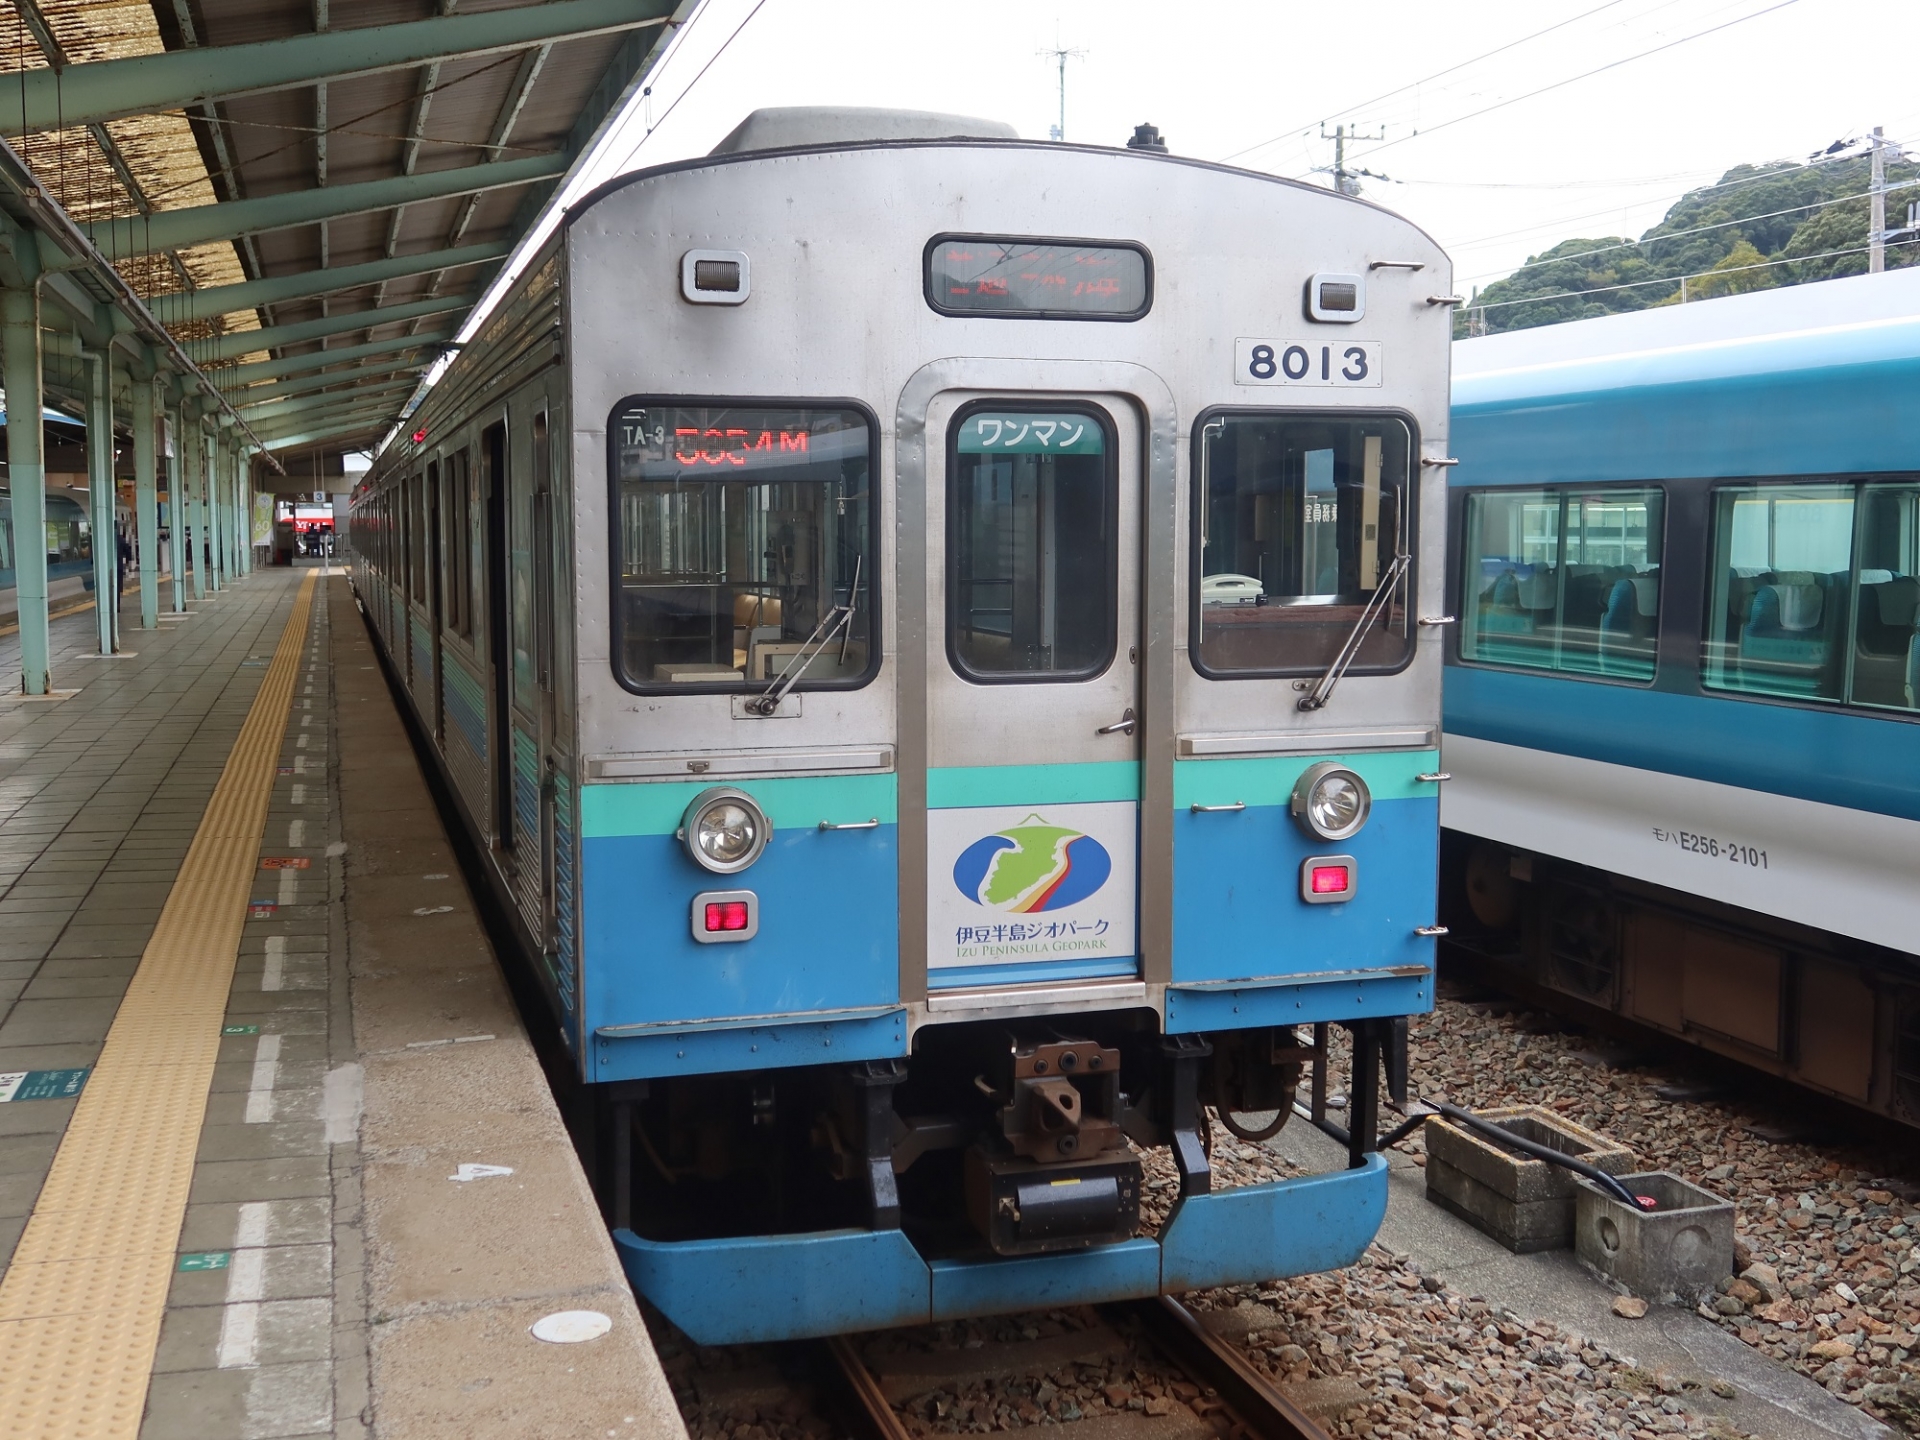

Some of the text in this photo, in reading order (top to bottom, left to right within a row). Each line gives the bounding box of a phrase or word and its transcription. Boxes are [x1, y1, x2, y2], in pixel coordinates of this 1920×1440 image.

[1249, 344, 1369, 381] 8013
[623, 425, 665, 446] TA-3
[977, 419, 1084, 447] ワンマン
[955, 918, 1110, 945] 伊豆半島ジオパーク
[956, 939, 1107, 958] IZU PENINSULA GEOPARK
